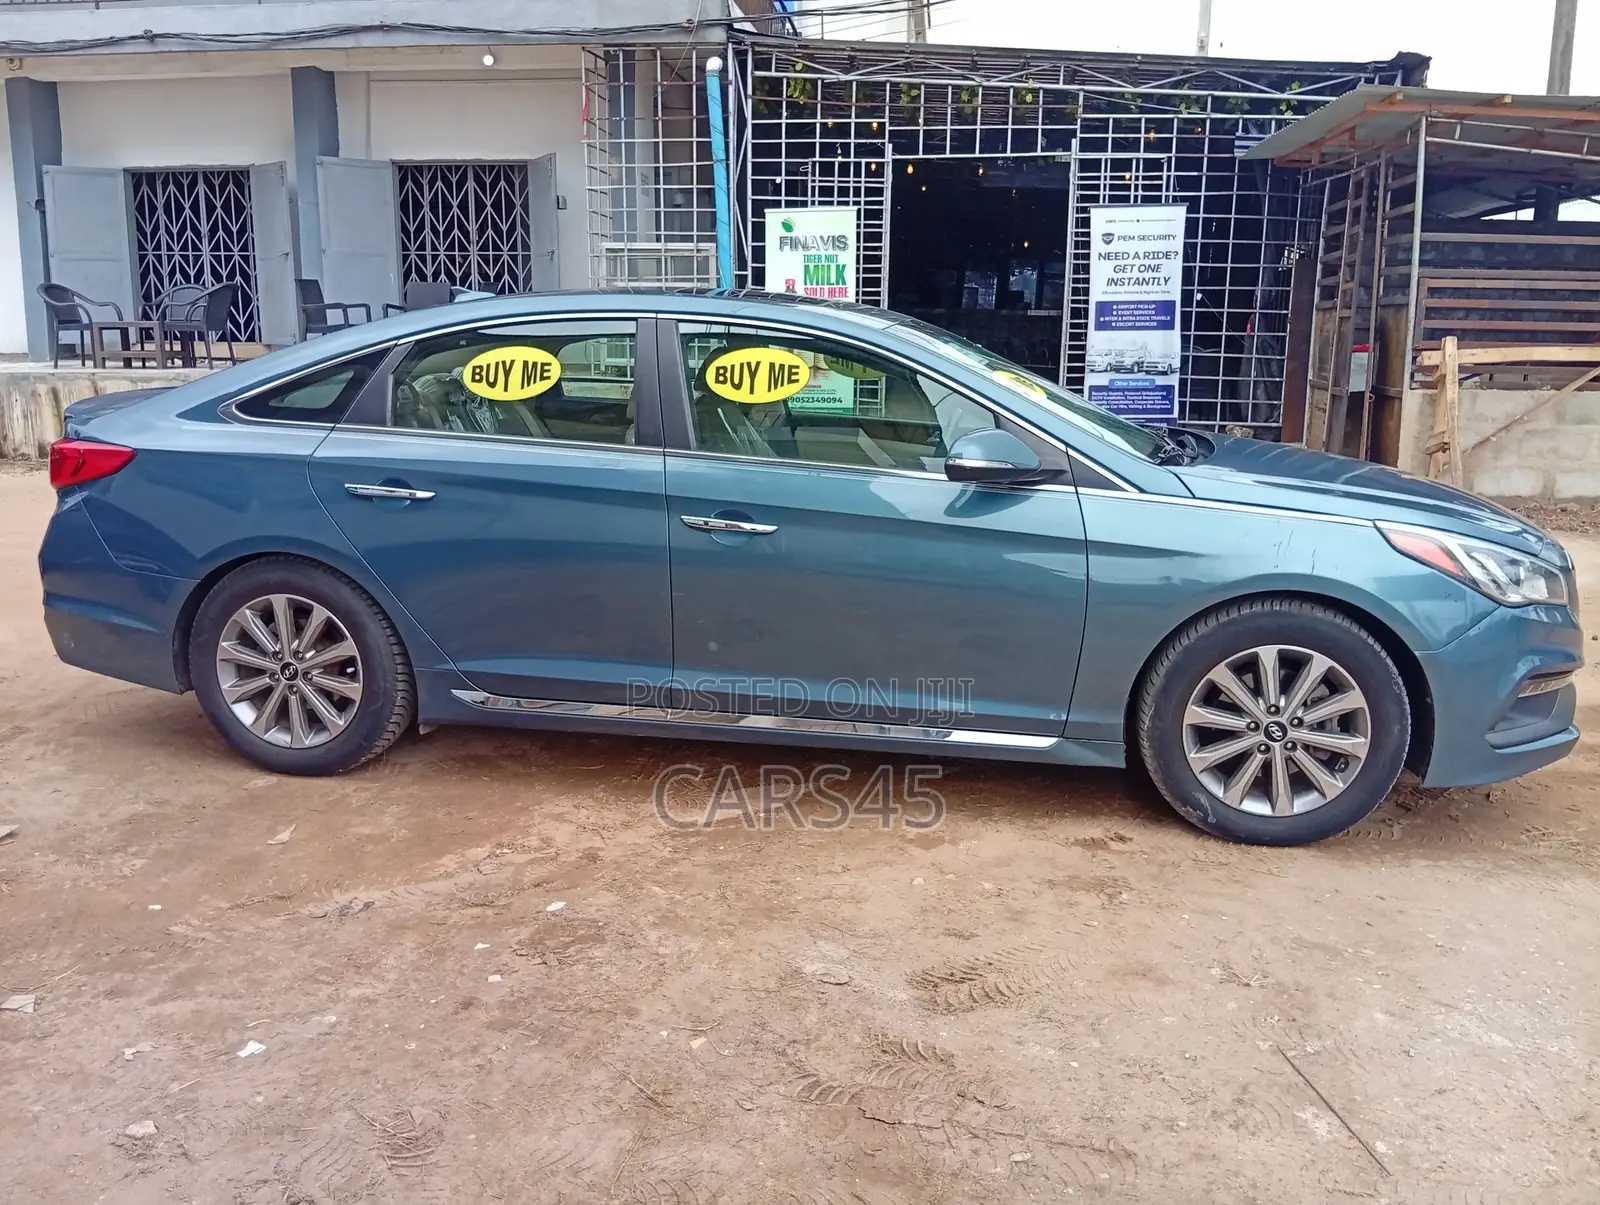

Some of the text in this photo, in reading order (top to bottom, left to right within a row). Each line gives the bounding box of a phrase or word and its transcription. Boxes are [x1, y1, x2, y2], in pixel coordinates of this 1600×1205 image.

[779, 235, 849, 252] FINAVIS
[803, 254, 839, 263] TIGER NUT
[1098, 251, 1179, 261] NEED A RIDE?
[1113, 264, 1163, 273] GET ONE
[803, 264, 847, 286] MILK
[1106, 276, 1171, 287] INSTANTLY
[804, 287, 849, 298] SOLD HERE
[471, 359, 552, 392] BUY ME
[714, 361, 762, 395] BUY
[767, 362, 800, 392] ME
